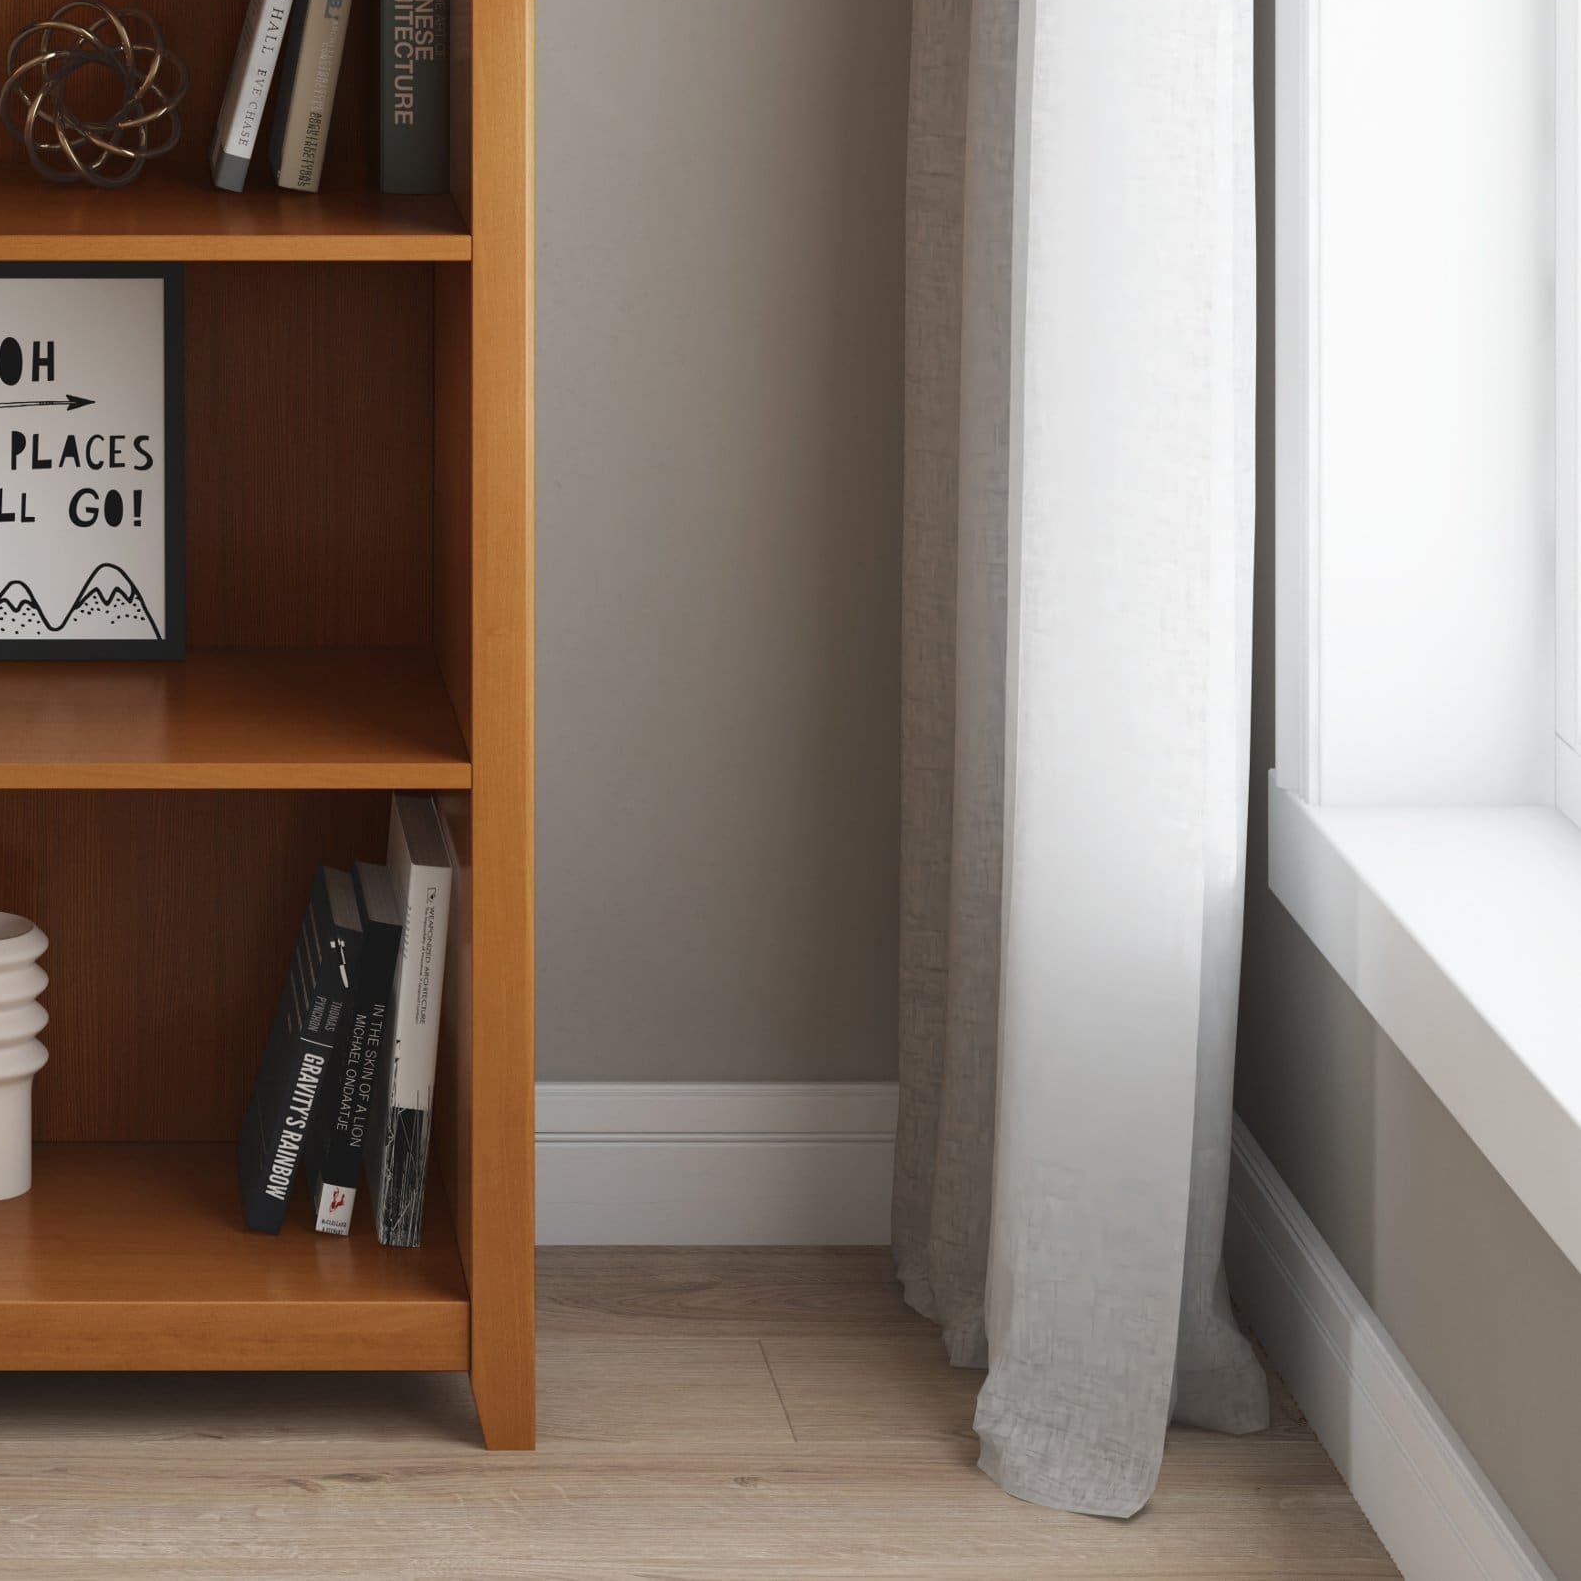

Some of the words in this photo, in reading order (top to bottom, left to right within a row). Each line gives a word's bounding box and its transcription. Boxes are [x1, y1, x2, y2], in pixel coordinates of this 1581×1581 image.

[260, 7, 284, 54] HALL
[251, 68, 268, 99] EVE
[238, 100, 259, 147] CHASE
[10, 430, 154, 471] PLACES
[68, 487, 143, 528] GO!
[425, 906, 435, 964] WEAPONIZED
[307, 995, 327, 1032] PYNCHON
[372, 1004, 386, 1018] IN
[419, 966, 430, 1024] ARCHITECTURE
[324, 1001, 343, 1032] THOMAS
[366, 1021, 383, 1047] THE
[347, 1014, 367, 1065] MICHAEL
[361, 1049, 377, 1080] SKIN
[285, 1053, 325, 1129] GRAVITY'S
[336, 1068, 358, 1131] ONDAATJE
[354, 1104, 368, 1113] A
[358, 1082, 371, 1102] OF
[349, 1116, 366, 1148] LION
[265, 1129, 303, 1201] RAINBOW
